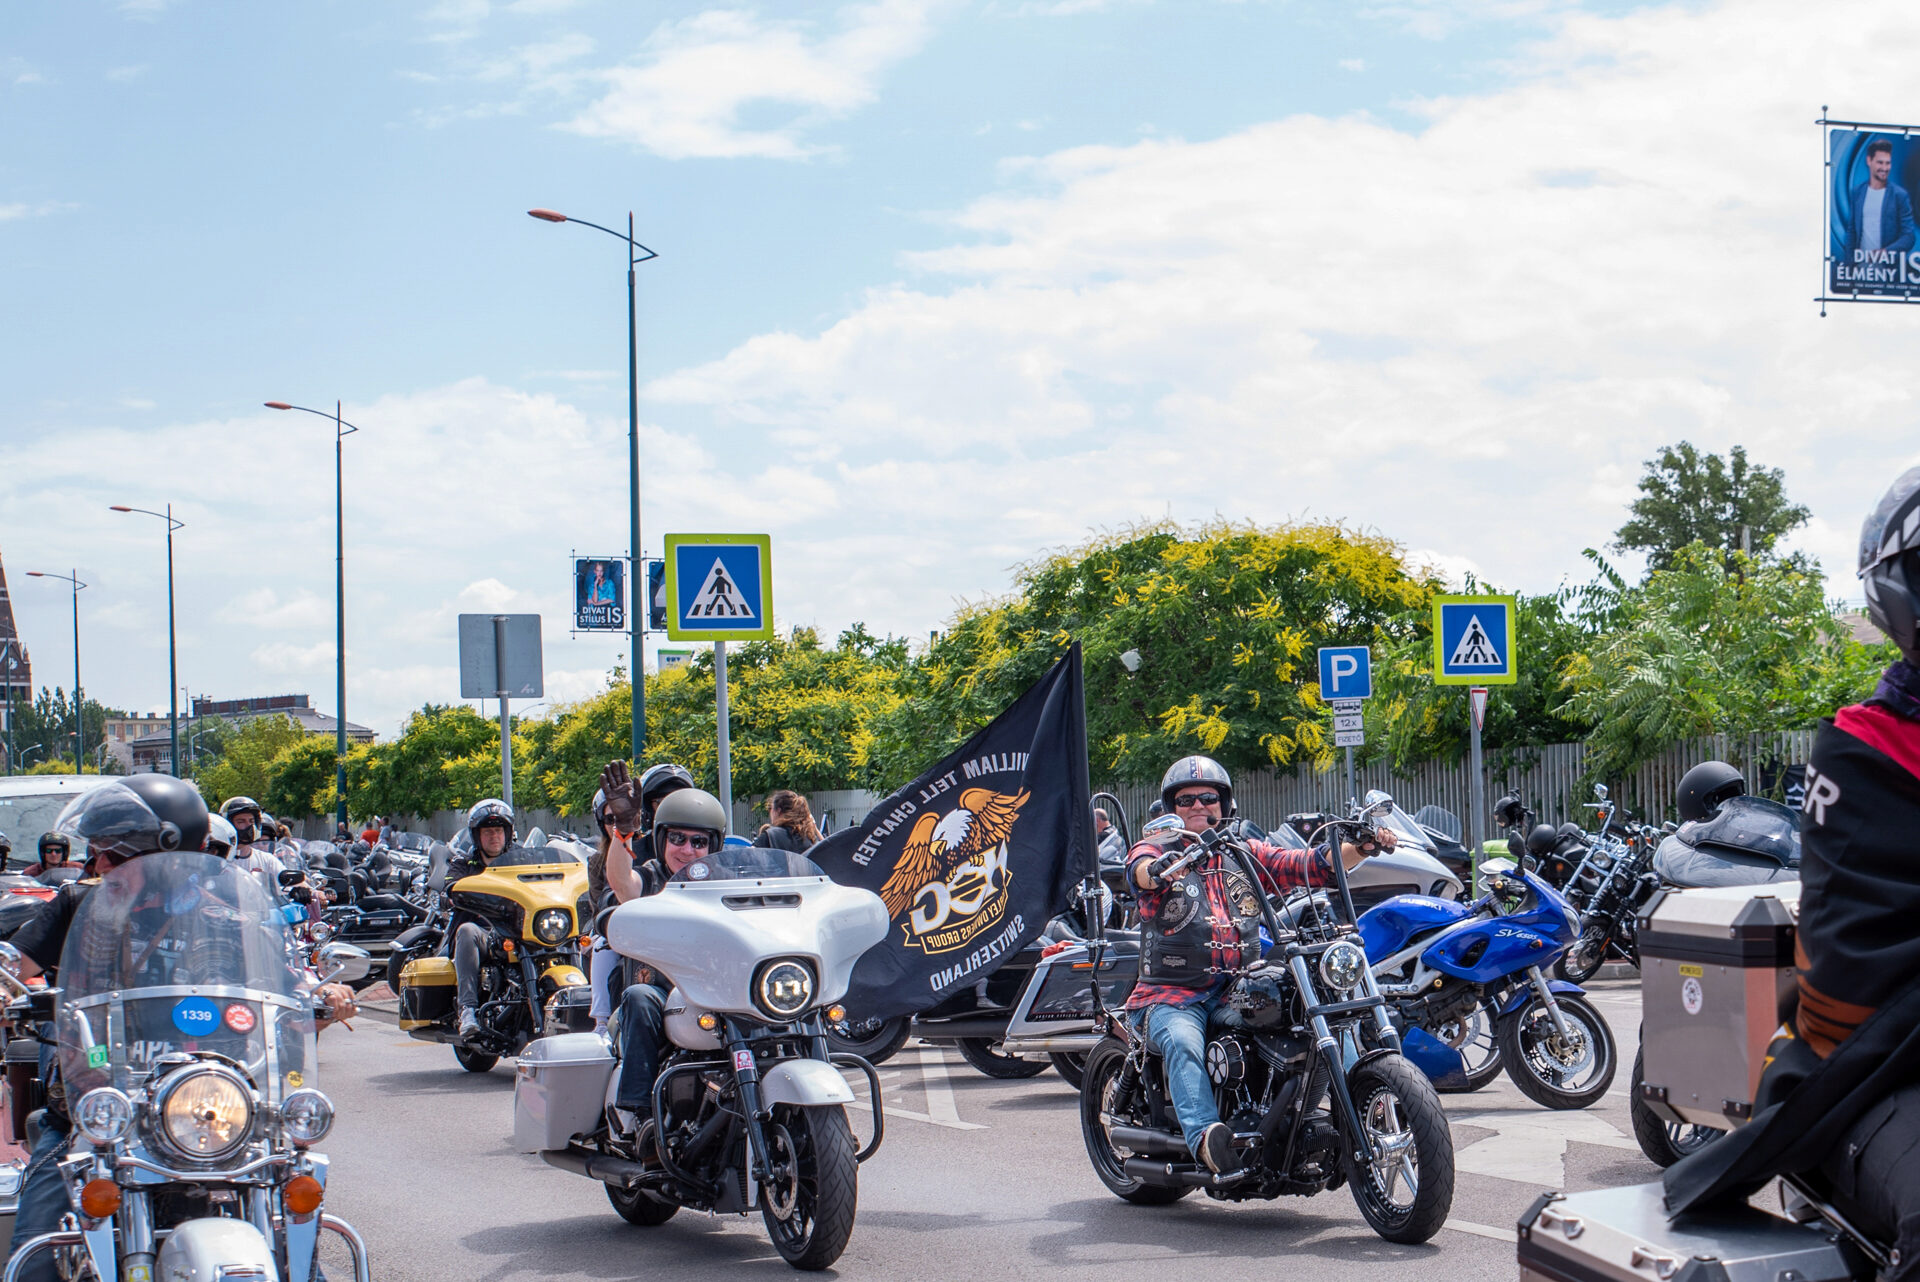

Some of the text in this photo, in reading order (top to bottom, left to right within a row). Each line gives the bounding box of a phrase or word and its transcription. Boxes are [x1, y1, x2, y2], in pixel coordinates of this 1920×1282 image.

[1854, 249, 1896, 264] DIVAT
[1837, 262, 1896, 282] ÉLMÉNY
[1900, 251, 1920, 284] IS
[607, 607, 622, 623] IS
[1331, 654, 1358, 692] P
[181, 1010, 213, 1021] 1339
